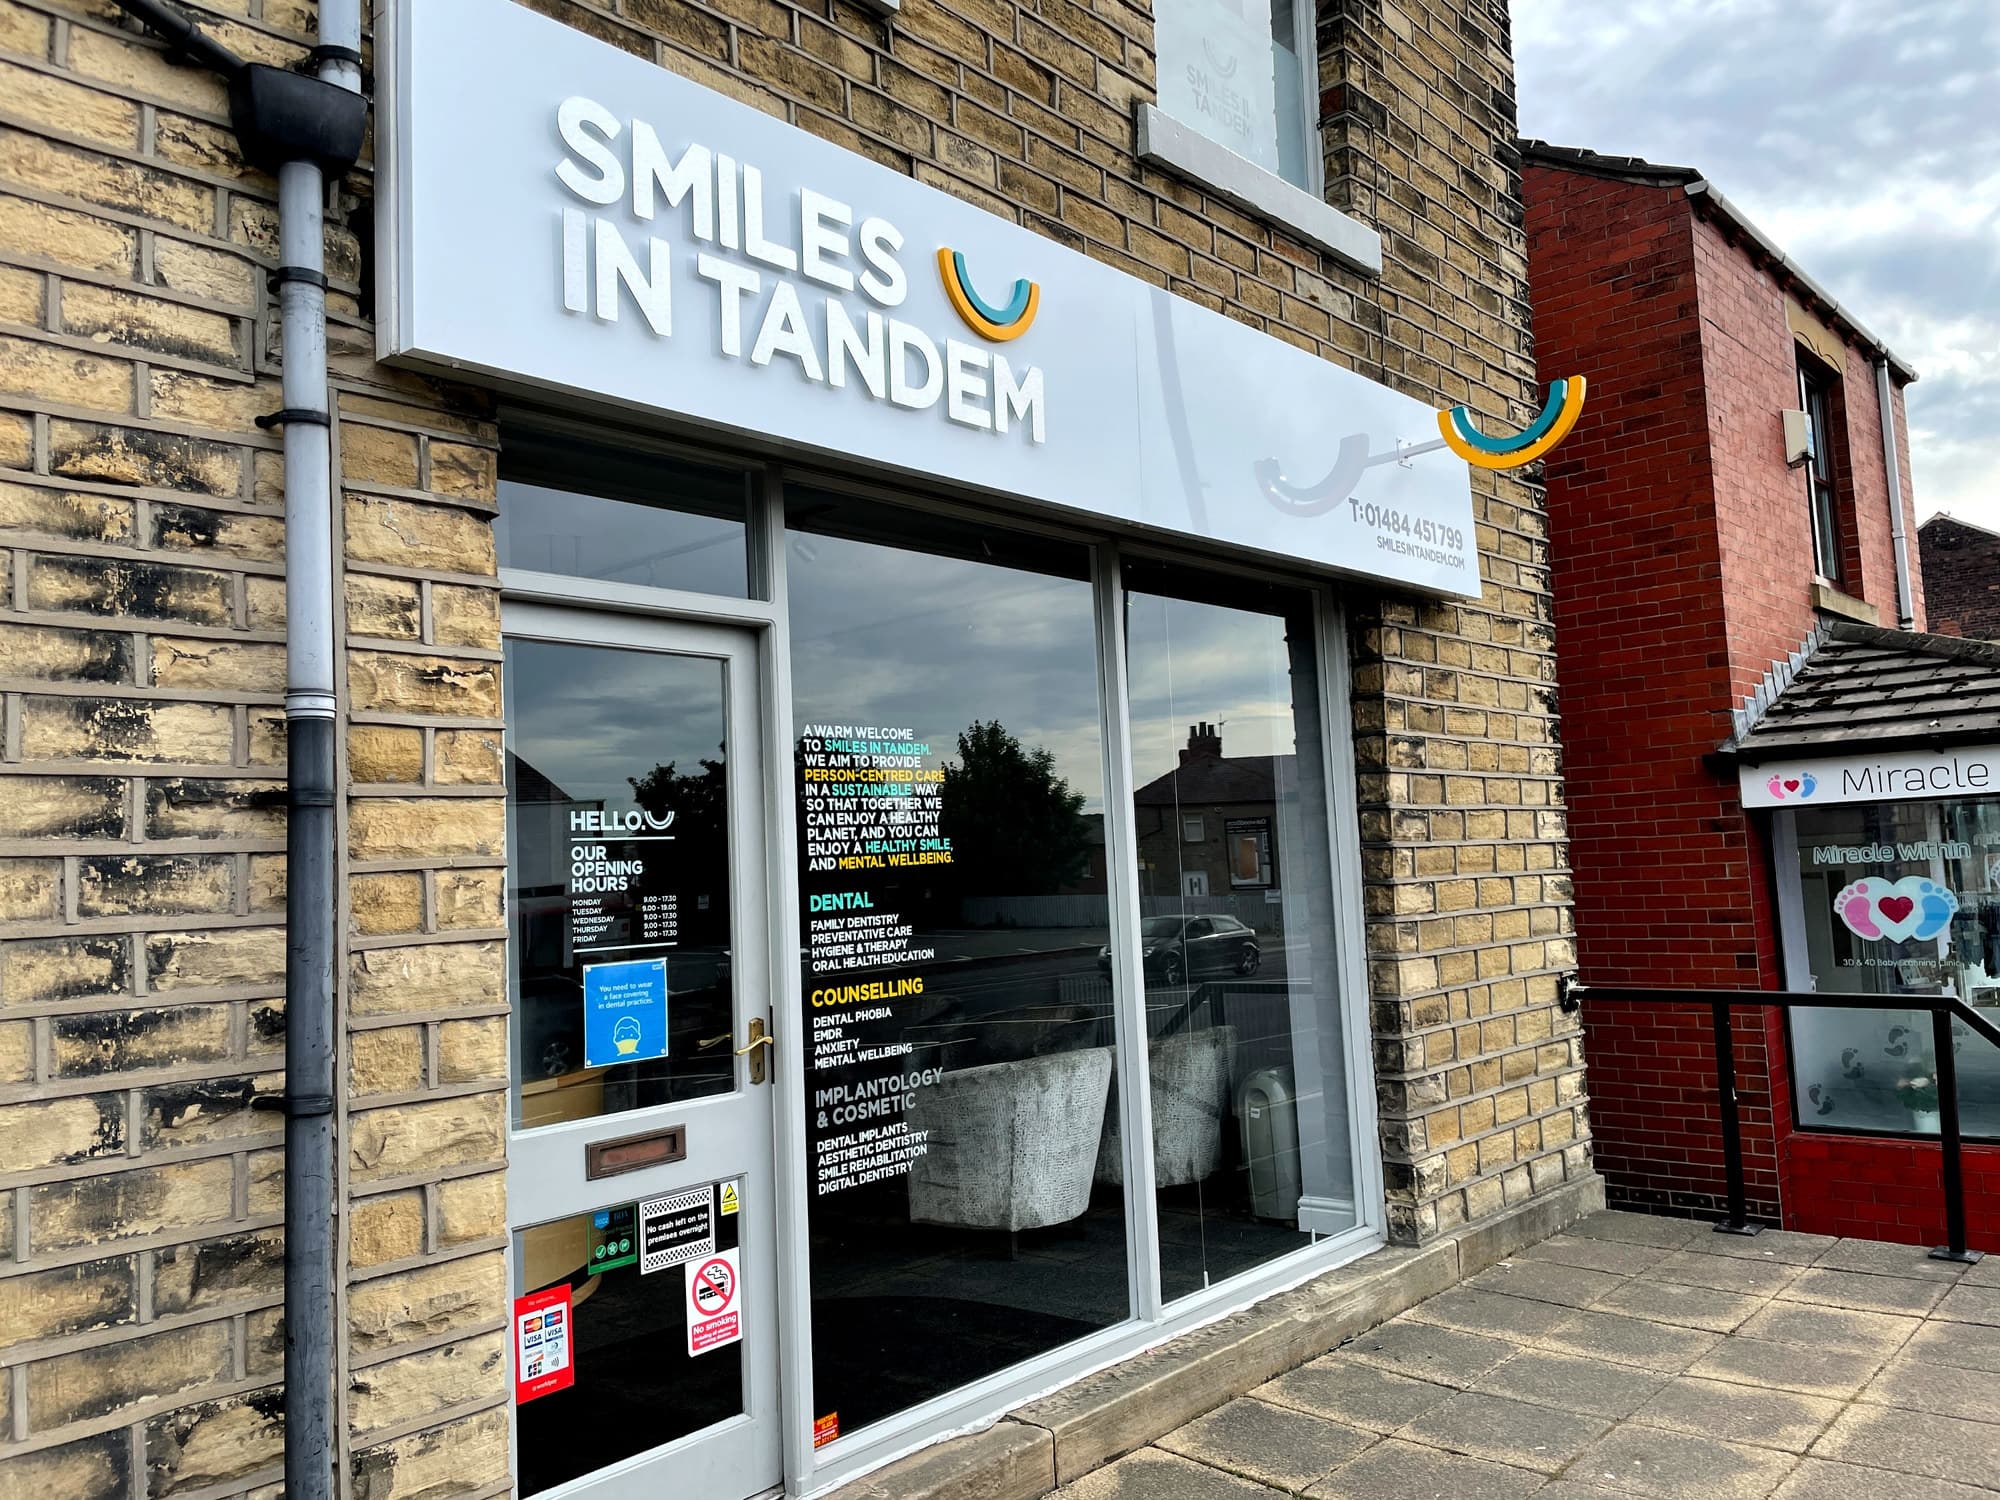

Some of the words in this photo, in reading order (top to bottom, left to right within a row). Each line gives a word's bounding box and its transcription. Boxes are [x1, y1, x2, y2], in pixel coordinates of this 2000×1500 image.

[554, 96, 907, 306] SMILES
[562, 207, 672, 337] IN
[697, 252, 1045, 445] TANDEM
[1414, 517, 1463, 551] 451799
[1377, 535, 1465, 570] SMILESINTANDEM.COM
[803, 725, 812, 738] A
[814, 725, 852, 738] WARM
[855, 727, 913, 740] WELCOME
[804, 739, 821, 751] TO
[825, 740, 867, 753] SMILES
[870, 742, 881, 753] IN
[883, 742, 932, 755] TANDEM.
[805, 754, 826, 767] WE
[828, 755, 850, 767] AIM
[853, 756, 870, 767] TO
[872, 756, 921, 767] PROVIDE
[805, 769, 913, 782] PERSON-CENTRED
[915, 770, 945, 782] CARE
[1842, 758, 1989, 795] Miracle
[805, 784, 818, 796] IN
[821, 784, 830, 796] A
[832, 784, 911, 796] SUSTAINABLE
[915, 784, 938, 795] WAY
[807, 799, 824, 811] SO
[827, 798, 858, 810] THAT
[861, 798, 922, 810] TOGETHER
[924, 798, 942, 809] WE
[571, 811, 646, 831] HELLO.
[807, 813, 834, 825] CAN
[837, 813, 876, 825] ENJOY
[879, 813, 888, 824] A
[890, 811, 940, 823] HEALTHY
[807, 828, 858, 841] PLANET,
[860, 827, 885, 839] AND
[888, 826, 912, 838] YOU
[914, 825, 938, 837] CAN
[571, 846, 606, 861] OUR
[808, 842, 850, 856] ENJOY
[853, 841, 862, 853] A
[866, 840, 917, 853] HEALTHY
[920, 838, 953, 852] SMILE,
[1813, 842, 1895, 865] Miracle
[572, 860, 643, 876] OPENING
[809, 858, 837, 871] AND
[839, 855, 885, 870] MENTAL
[888, 852, 954, 866] WELLBEING.
[572, 876, 628, 892] HOURS
[572, 898, 601, 906] MONDAY
[810, 892, 873, 912] DENTAL
[572, 907, 603, 916] TUESDAY
[572, 915, 615, 925] WEDNESDAY
[572, 925, 608, 934] THURSDAY
[811, 918, 845, 931] FAMILY
[847, 914, 899, 928] DENTISTRY
[572, 935, 597, 943] FRIDAY
[812, 928, 885, 944] PREVENTATIVE
[887, 926, 912, 937] CARE
[812, 944, 854, 958] HYGIENE
[857, 943, 863, 953] &
[864, 939, 908, 952] THERAPY
[812, 958, 841, 971] ORAL
[843, 953, 880, 968] HEALTH
[882, 949, 934, 964] EDUCATION
[812, 977, 923, 1007] COUNSELLING
[814, 1013, 853, 1028] DENTAL
[856, 1007, 892, 1021] PHOBIA
[814, 1028, 842, 1042] EMDR
[815, 1038, 859, 1056] ANXIETY
[815, 1053, 855, 1070] MENTAL
[858, 1043, 912, 1062] WELLBEING
[816, 1067, 943, 1108] IMPLANTOLOGY
[817, 1111, 828, 1128] &
[833, 1092, 916, 1124] COSMETIC
[817, 1134, 857, 1152] DENTAL
[859, 1122, 908, 1142] IMPLANTS
[818, 1144, 874, 1167] AESTHETIC
[876, 1130, 928, 1152] DENTISTRY
[818, 1165, 849, 1180] SMILE
[850, 1144, 927, 1173] REHABILITATION
[819, 1178, 858, 1195] DIGITAL
[859, 1160, 914, 1185] DENTISTRY
[647, 1226, 656, 1234] No
[658, 1221, 674, 1231] cash
[698, 1213, 708, 1221] the
[648, 1232, 677, 1246] premises
[548, 1327, 562, 1336] VISA
[693, 1326, 704, 1335] No
[706, 1314, 736, 1330] smoking
[527, 1334, 541, 1343] VISA
